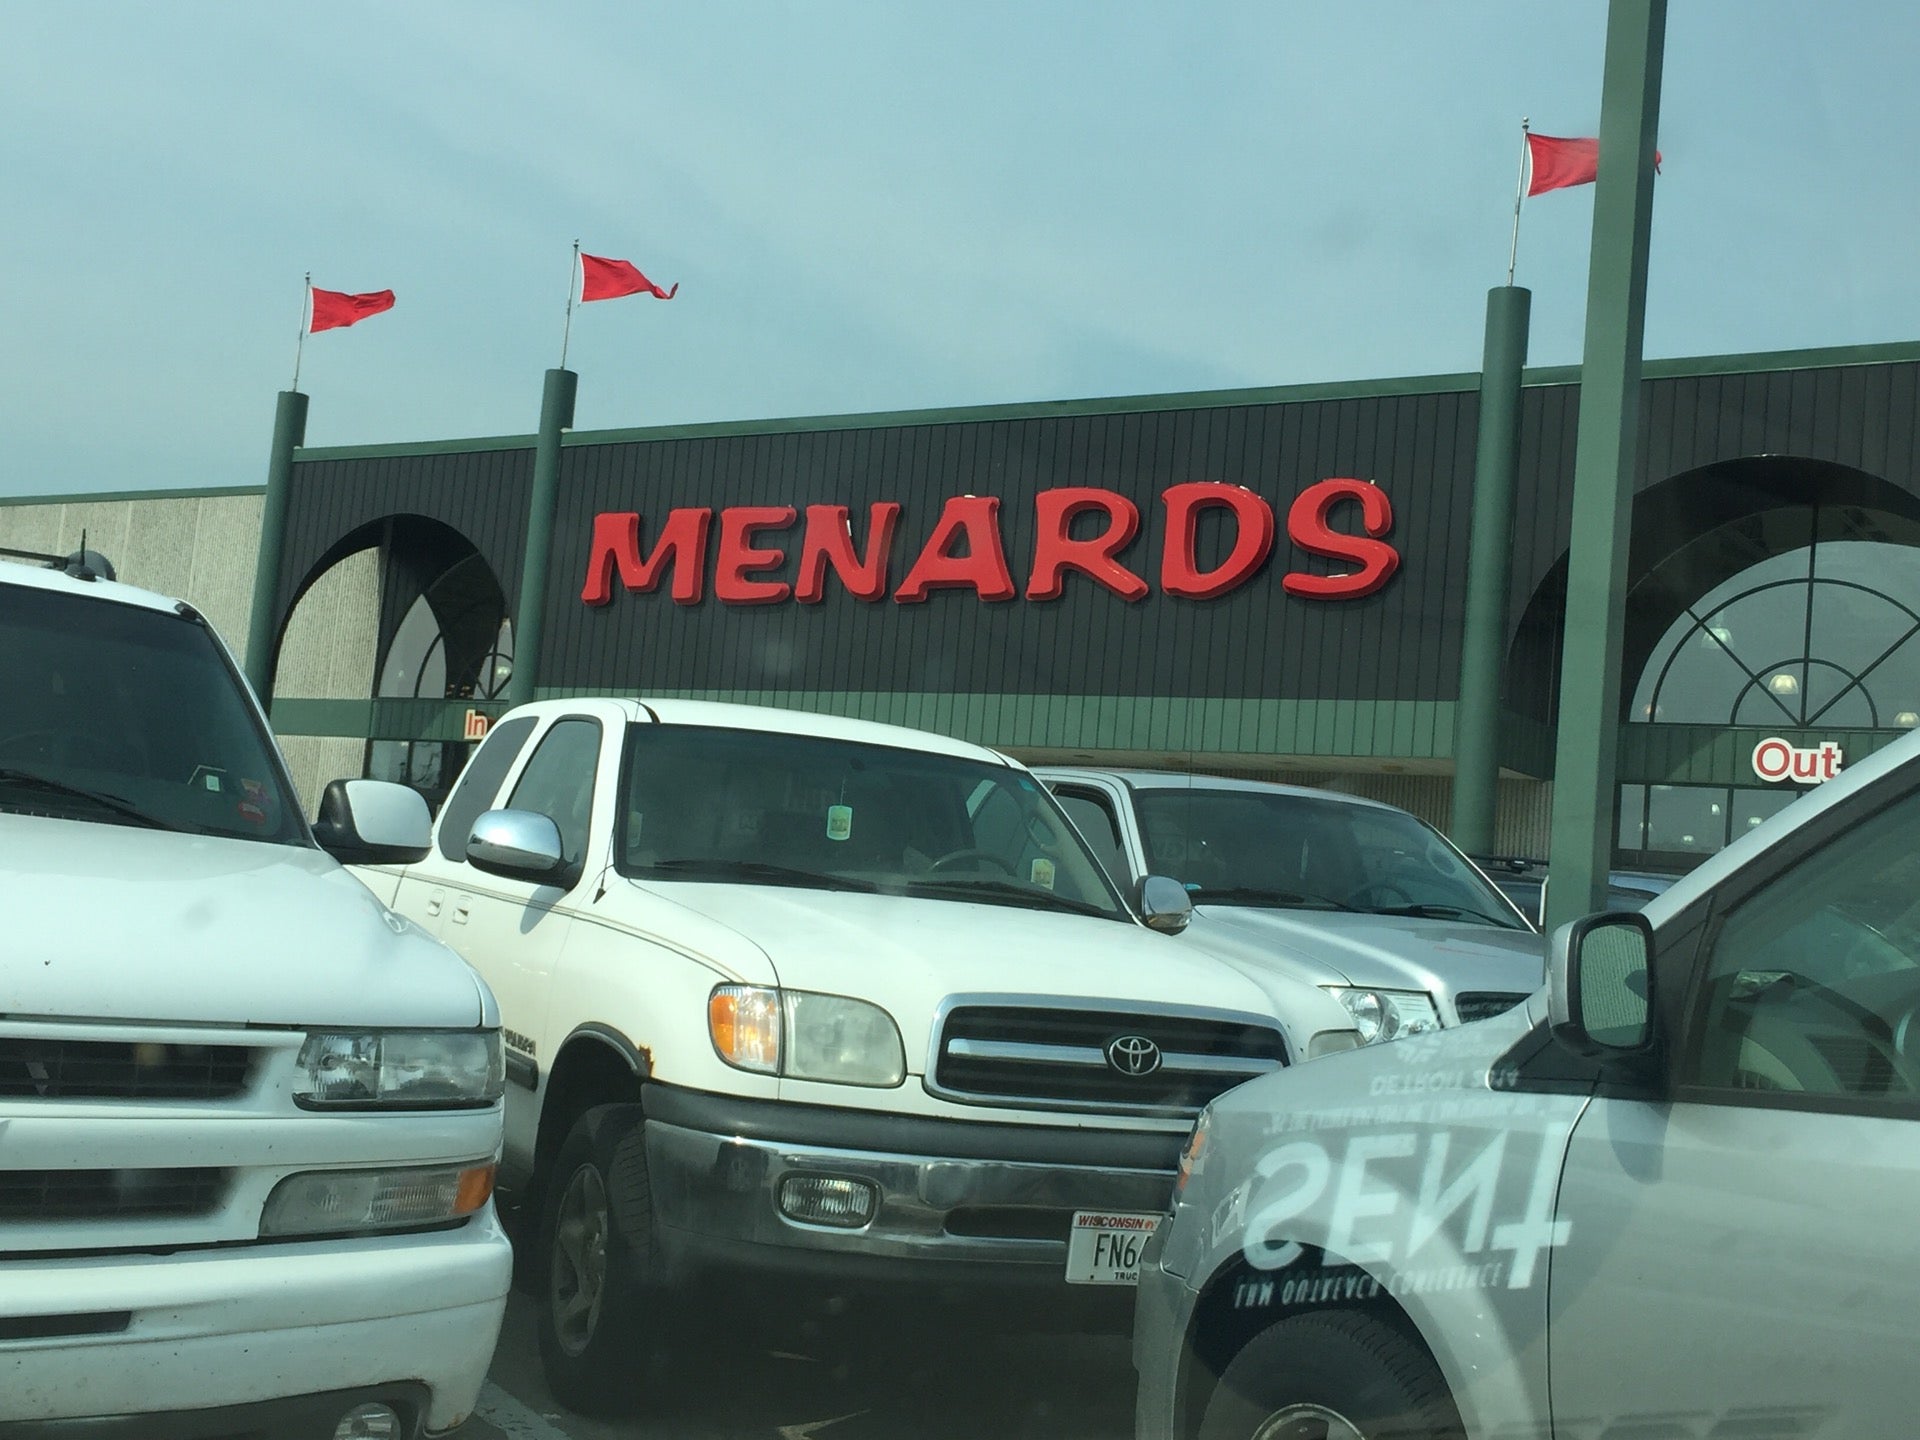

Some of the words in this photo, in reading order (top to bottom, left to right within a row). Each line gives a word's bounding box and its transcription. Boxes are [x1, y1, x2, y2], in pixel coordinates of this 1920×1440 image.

[581, 479, 1400, 606] MENARDS
[464, 709, 488, 740] In
[1752, 737, 1842, 783] Out
[1078, 1215, 1144, 1229] WISCONSIN
